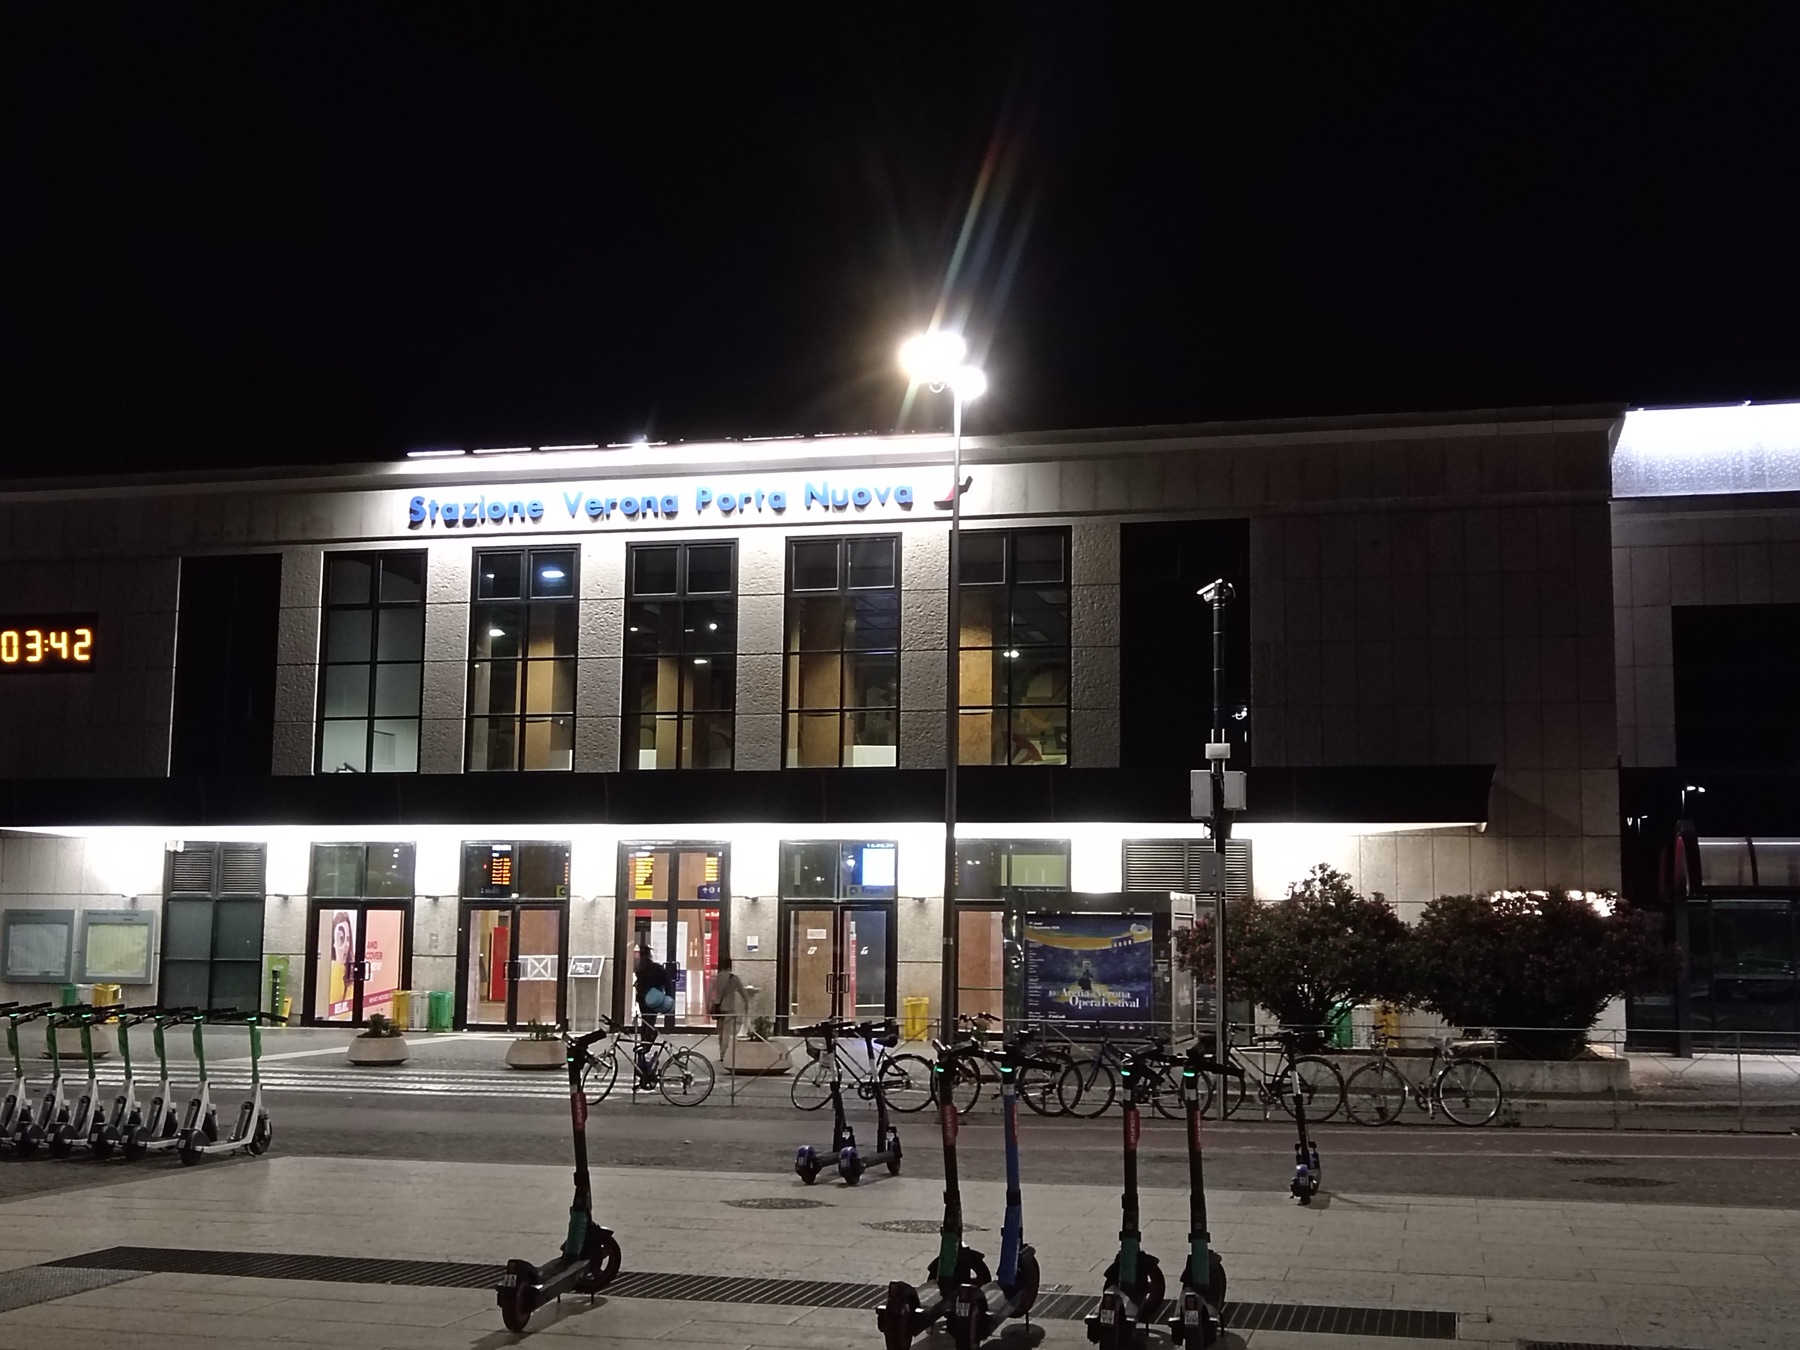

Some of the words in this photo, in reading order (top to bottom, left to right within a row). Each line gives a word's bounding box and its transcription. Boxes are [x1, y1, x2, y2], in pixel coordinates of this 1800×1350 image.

[409, 495, 545, 523] Stazione
[563, 491, 679, 517] Verona
[696, 486, 786, 512] Porta
[805, 481, 914, 508] Nuova
[1, 629, 91, 662] 03:42
[1069, 994, 1101, 1009] Opera
[1102, 997, 1139, 1008] Festival
